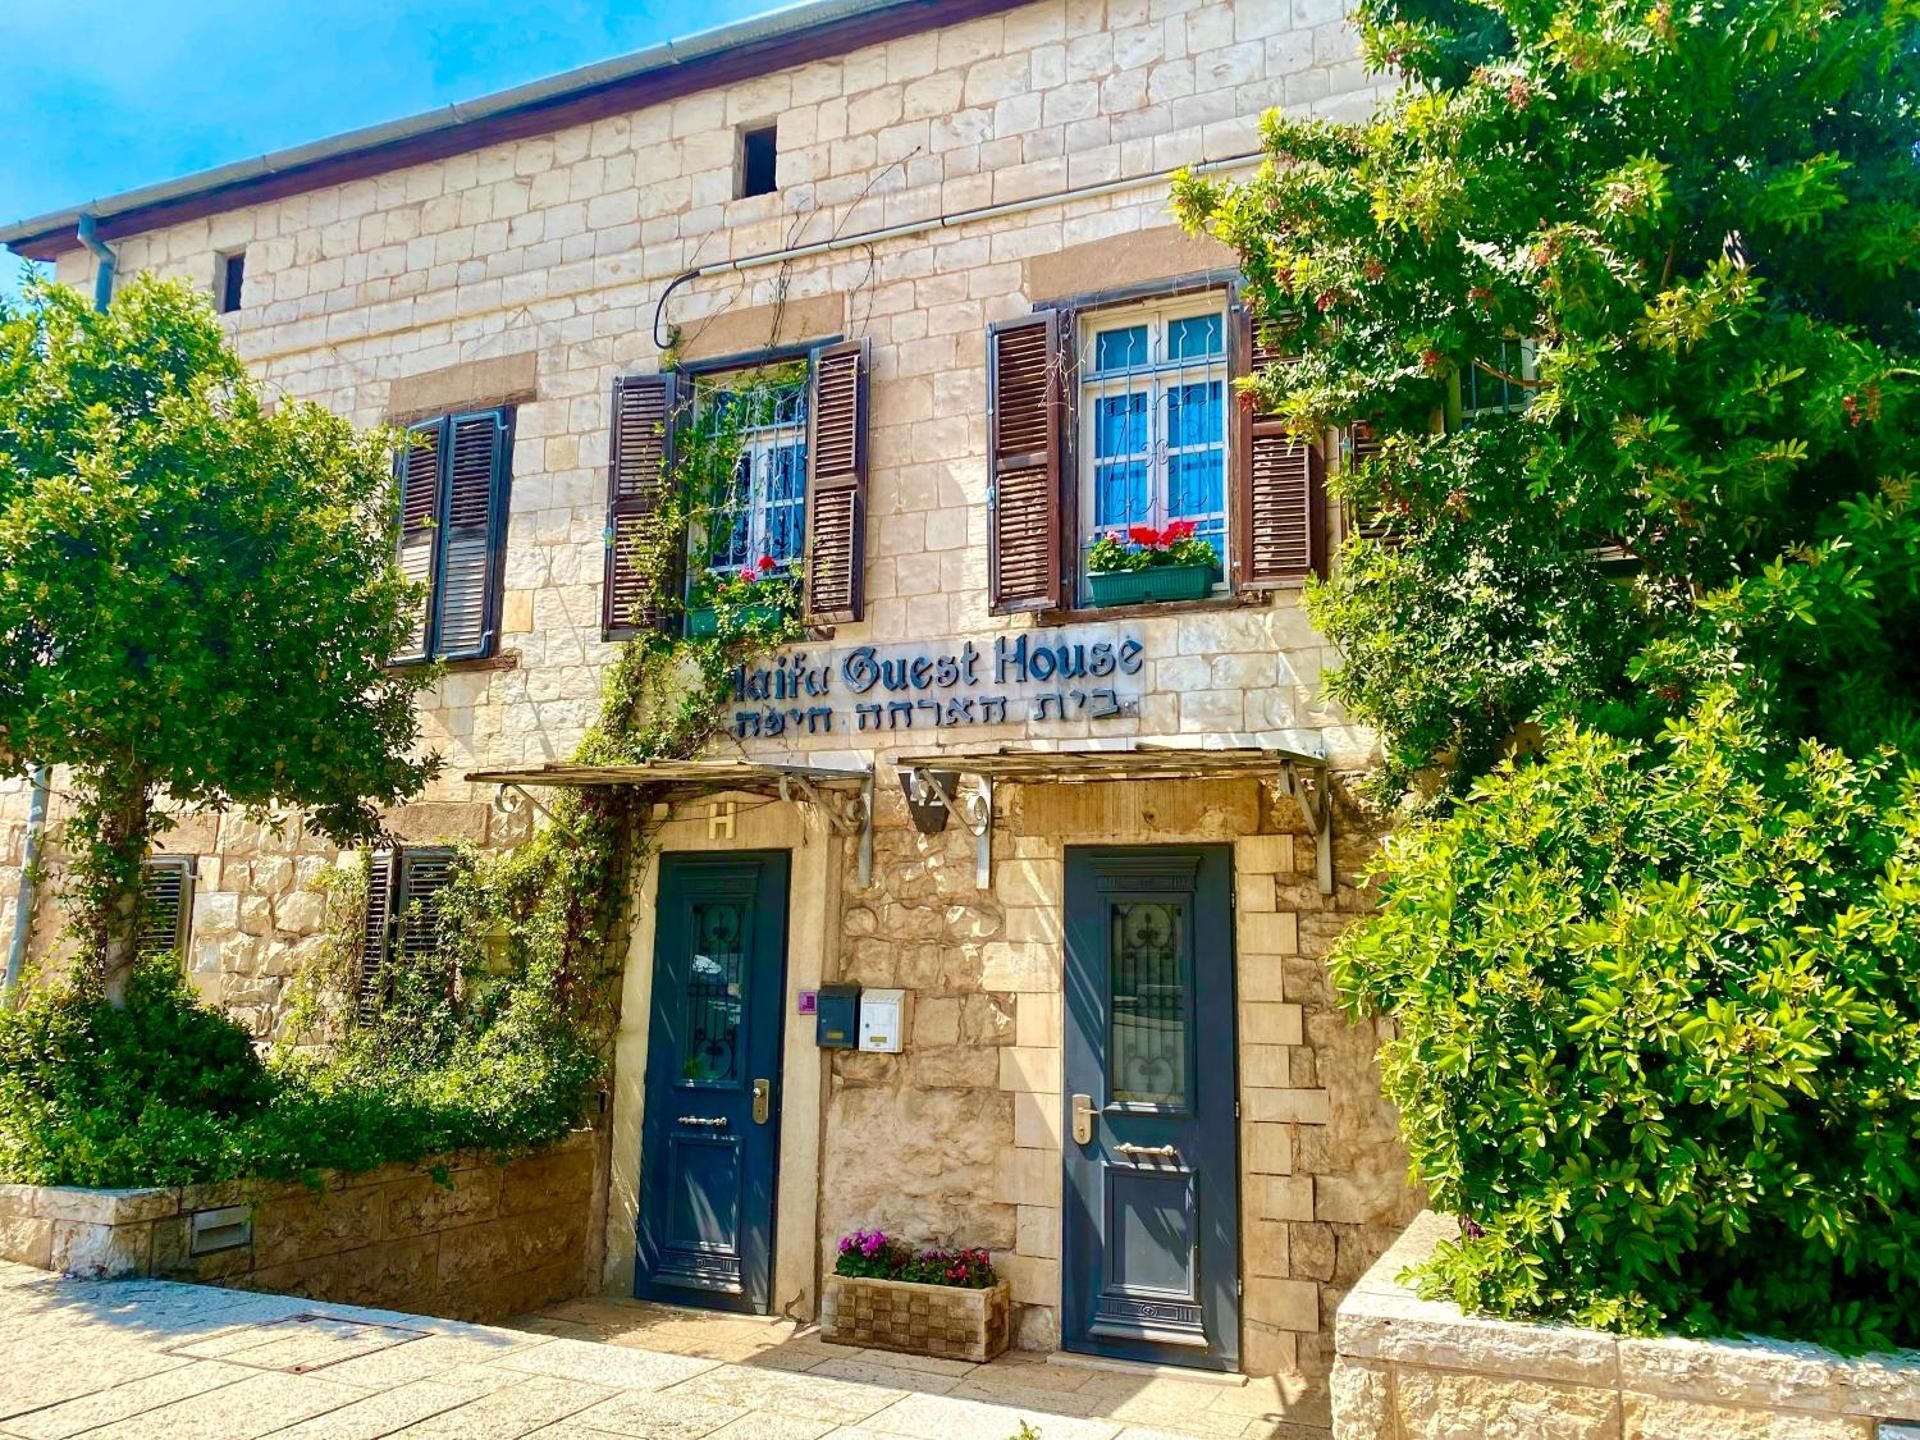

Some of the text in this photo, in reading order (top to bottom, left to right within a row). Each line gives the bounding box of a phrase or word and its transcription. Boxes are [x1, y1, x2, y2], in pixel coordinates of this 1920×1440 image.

[842, 640, 980, 694] Guest
[994, 633, 1144, 684] House
[734, 687, 1121, 738] בית הארחה חיפה
[708, 801, 737, 840] H
